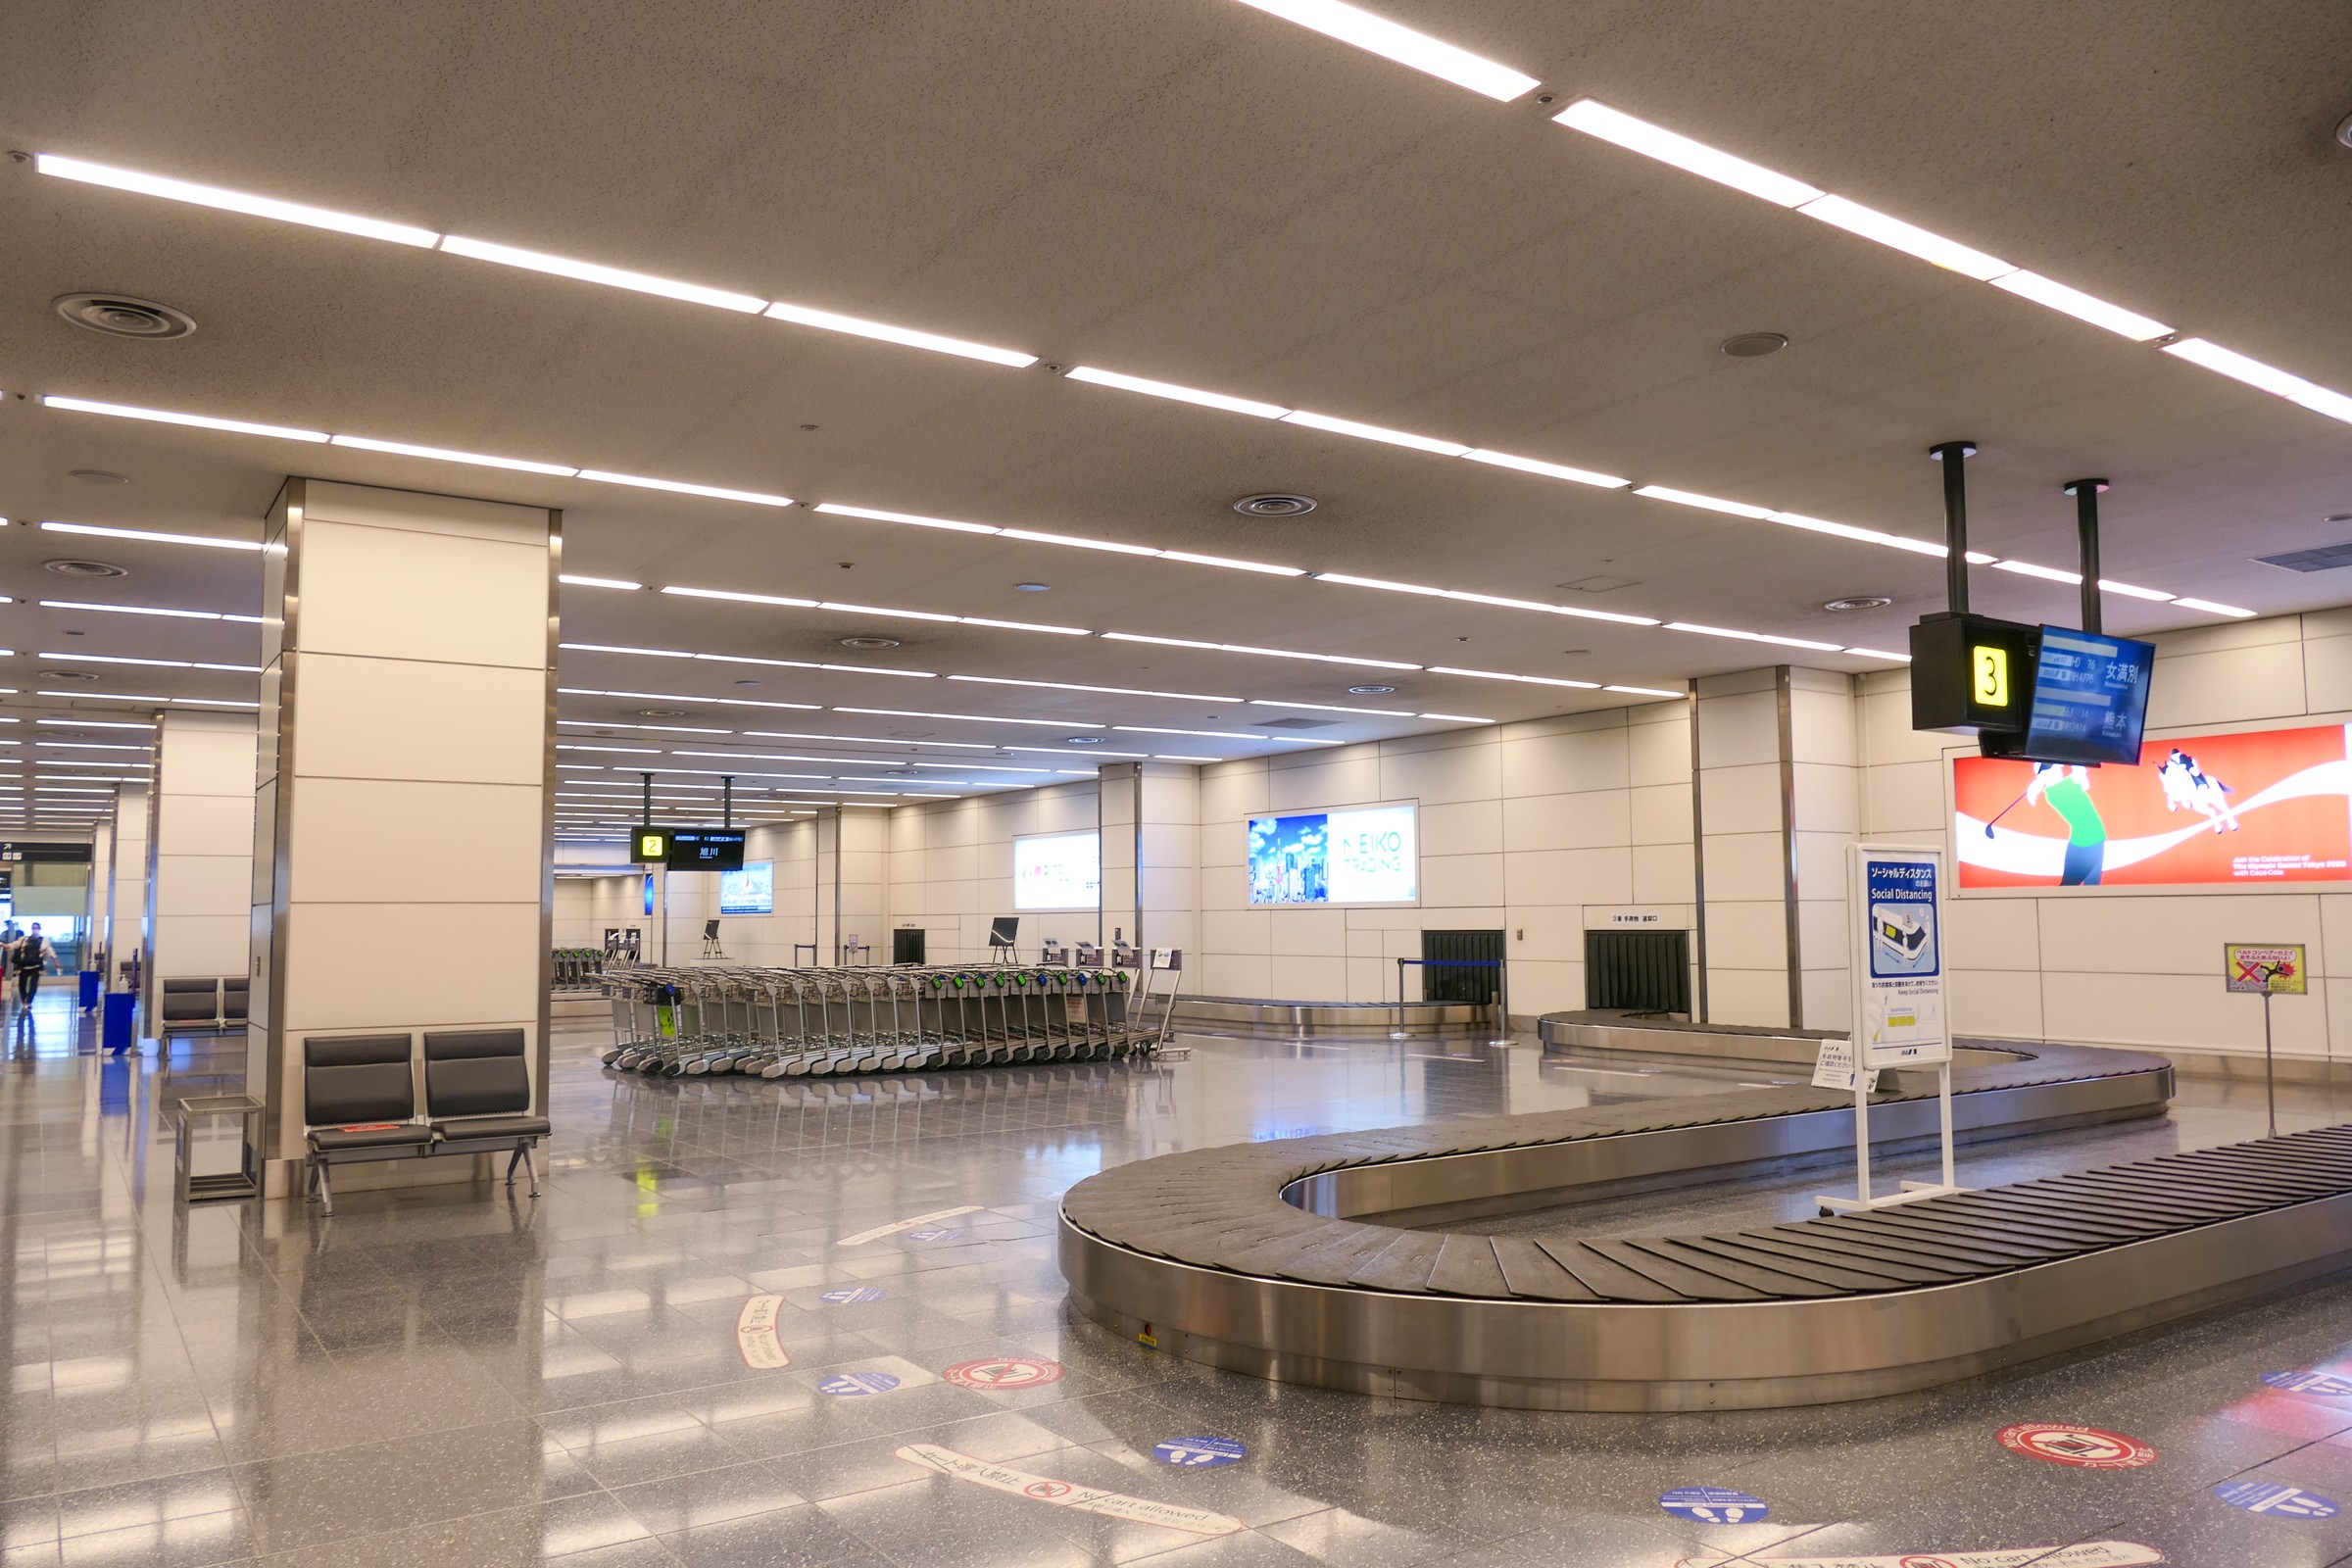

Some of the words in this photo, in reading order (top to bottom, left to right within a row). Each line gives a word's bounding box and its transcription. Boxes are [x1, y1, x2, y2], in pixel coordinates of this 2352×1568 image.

[2086, 659, 2096, 670] 76
[1985, 656, 1997, 697] 3
[2105, 662, 2139, 684] 女満別
[2102, 710, 2128, 731] 熊本
[648, 839, 657, 853] 2
[700, 847, 718, 856] 旭川
[1871, 867, 1932, 879] ソーシャルディスタンス
[1871, 888, 1893, 900] Social
[1895, 889, 1933, 903] Distancing
[2021, 1423, 2089, 1433] allowed
[1078, 1491, 1100, 1500] No
[1103, 1496, 1138, 1511] cart
[1139, 1504, 1210, 1522] allowed
[1960, 1556, 1990, 1566] No
[1994, 1553, 2031, 1565] cart
